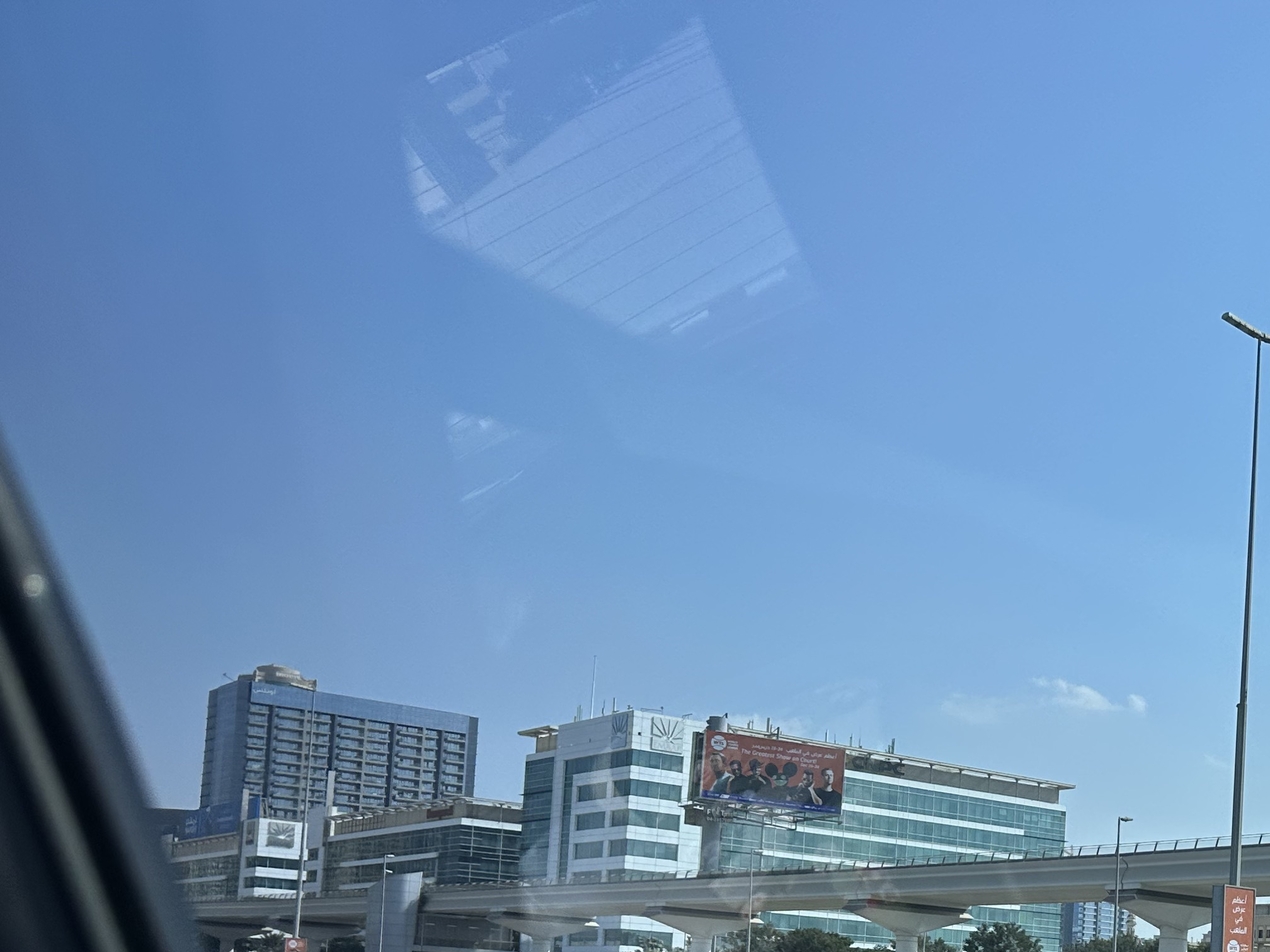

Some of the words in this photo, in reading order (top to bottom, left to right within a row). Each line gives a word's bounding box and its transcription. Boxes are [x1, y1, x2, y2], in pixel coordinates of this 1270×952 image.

[752, 750, 775, 759] Greatest
[776, 753, 792, 761] Show
[1231, 895, 1247, 905] أعظم
[1234, 916, 1244, 924] في
[1229, 927, 1247, 935] الملعب
